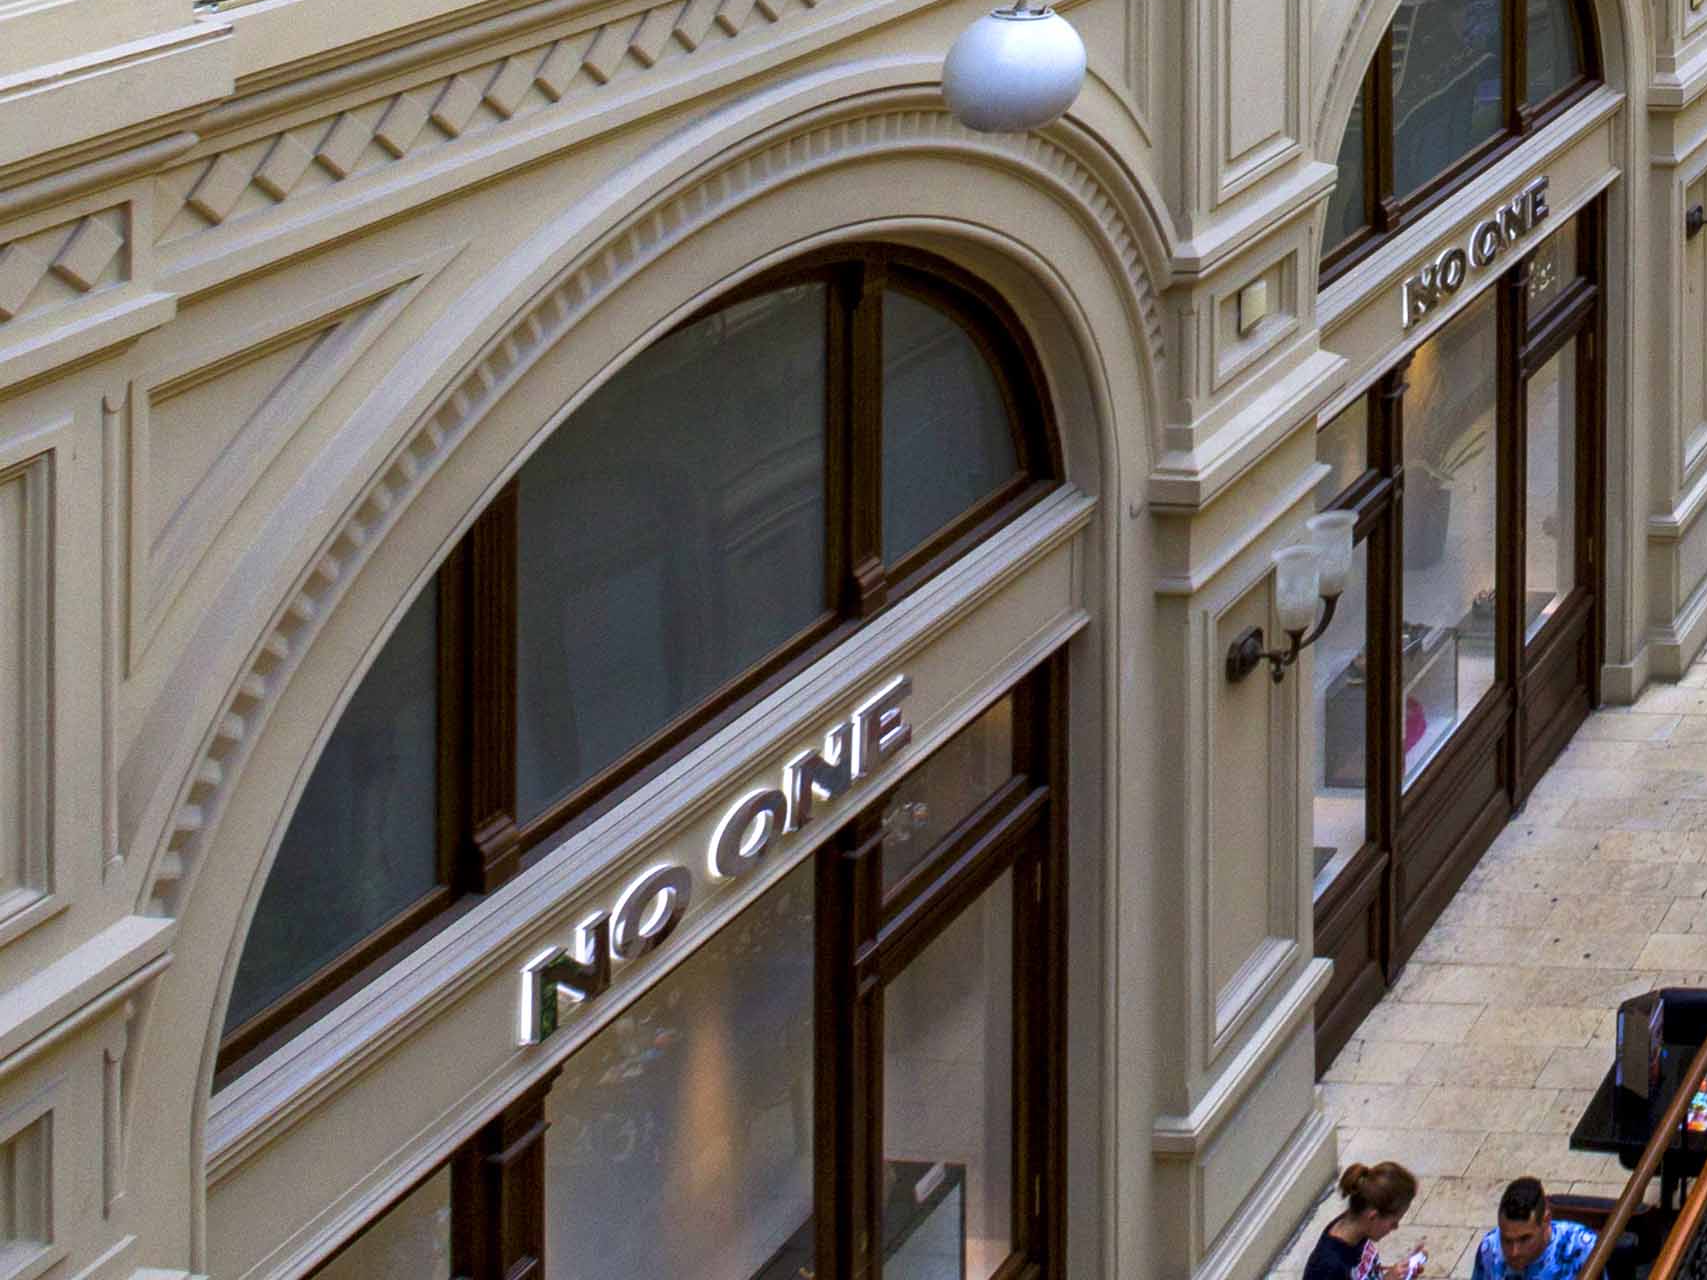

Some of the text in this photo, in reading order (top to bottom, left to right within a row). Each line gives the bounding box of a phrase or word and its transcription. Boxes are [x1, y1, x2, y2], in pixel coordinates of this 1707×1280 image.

[1402, 246, 1467, 329] NO
[1470, 175, 1550, 267] ONE
[519, 673, 914, 1047] NO ONE
